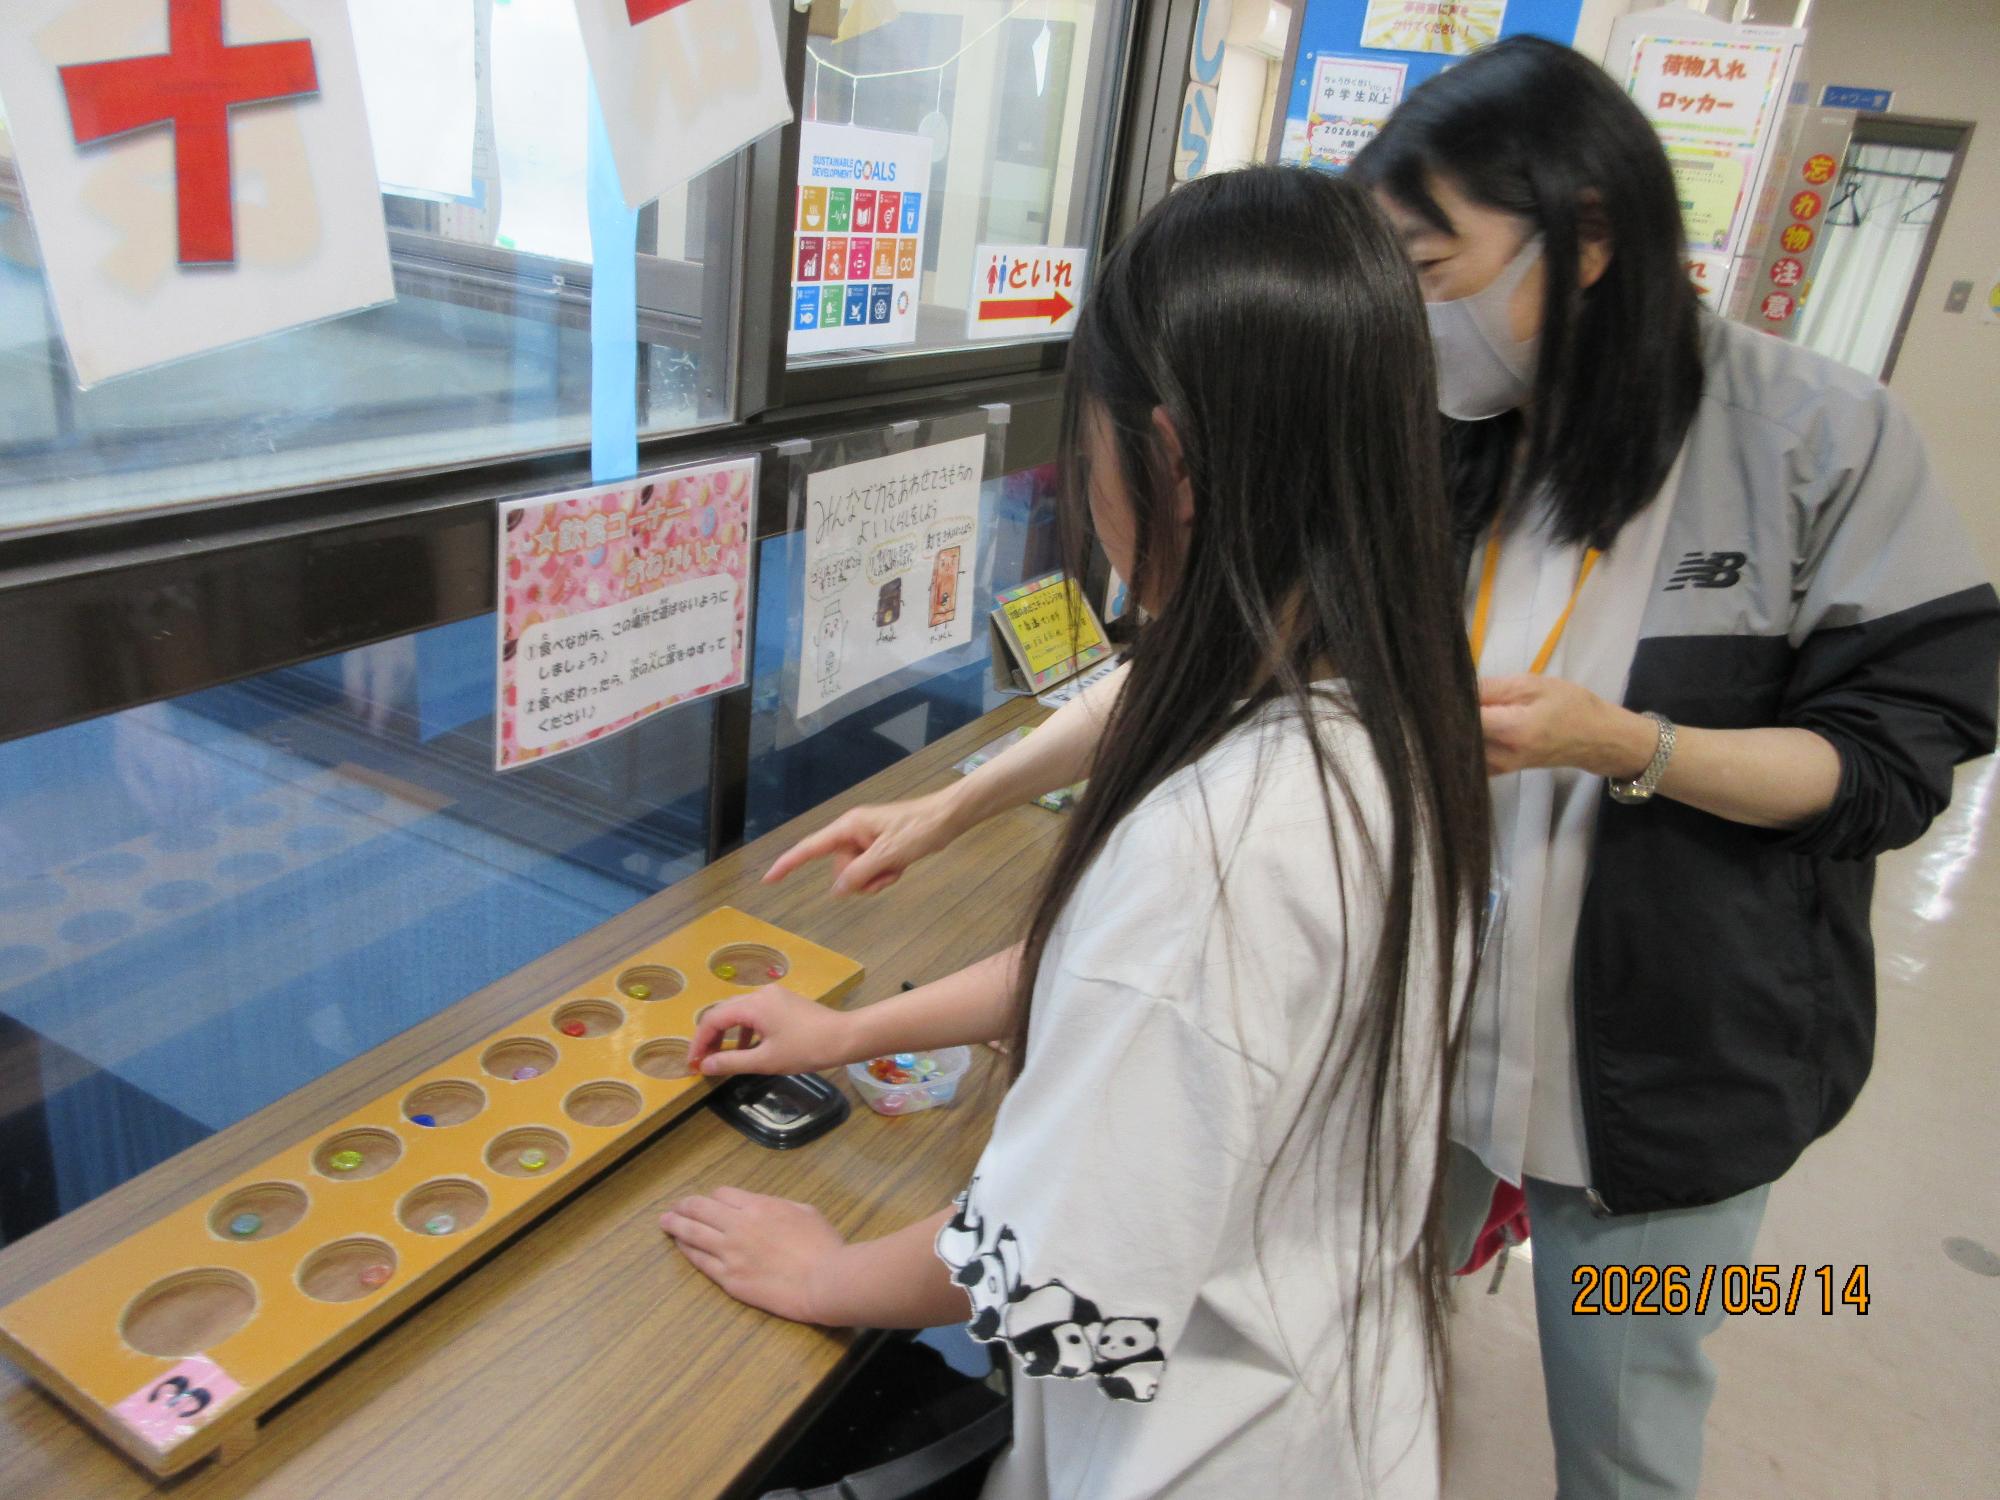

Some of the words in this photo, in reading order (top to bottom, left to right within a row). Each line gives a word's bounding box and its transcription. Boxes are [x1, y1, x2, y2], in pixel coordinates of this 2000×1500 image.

[1662, 53, 1747, 81] 荷物入れ
[1323, 88, 1391, 105] 中学生以上
[1657, 91, 1735, 114] ロッカー
[812, 155, 854, 168] SUSTAINABLE
[853, 159, 897, 181] GOALS
[811, 167, 854, 179] DEVELOPMENT
[1008, 258, 1073, 289] といれ
